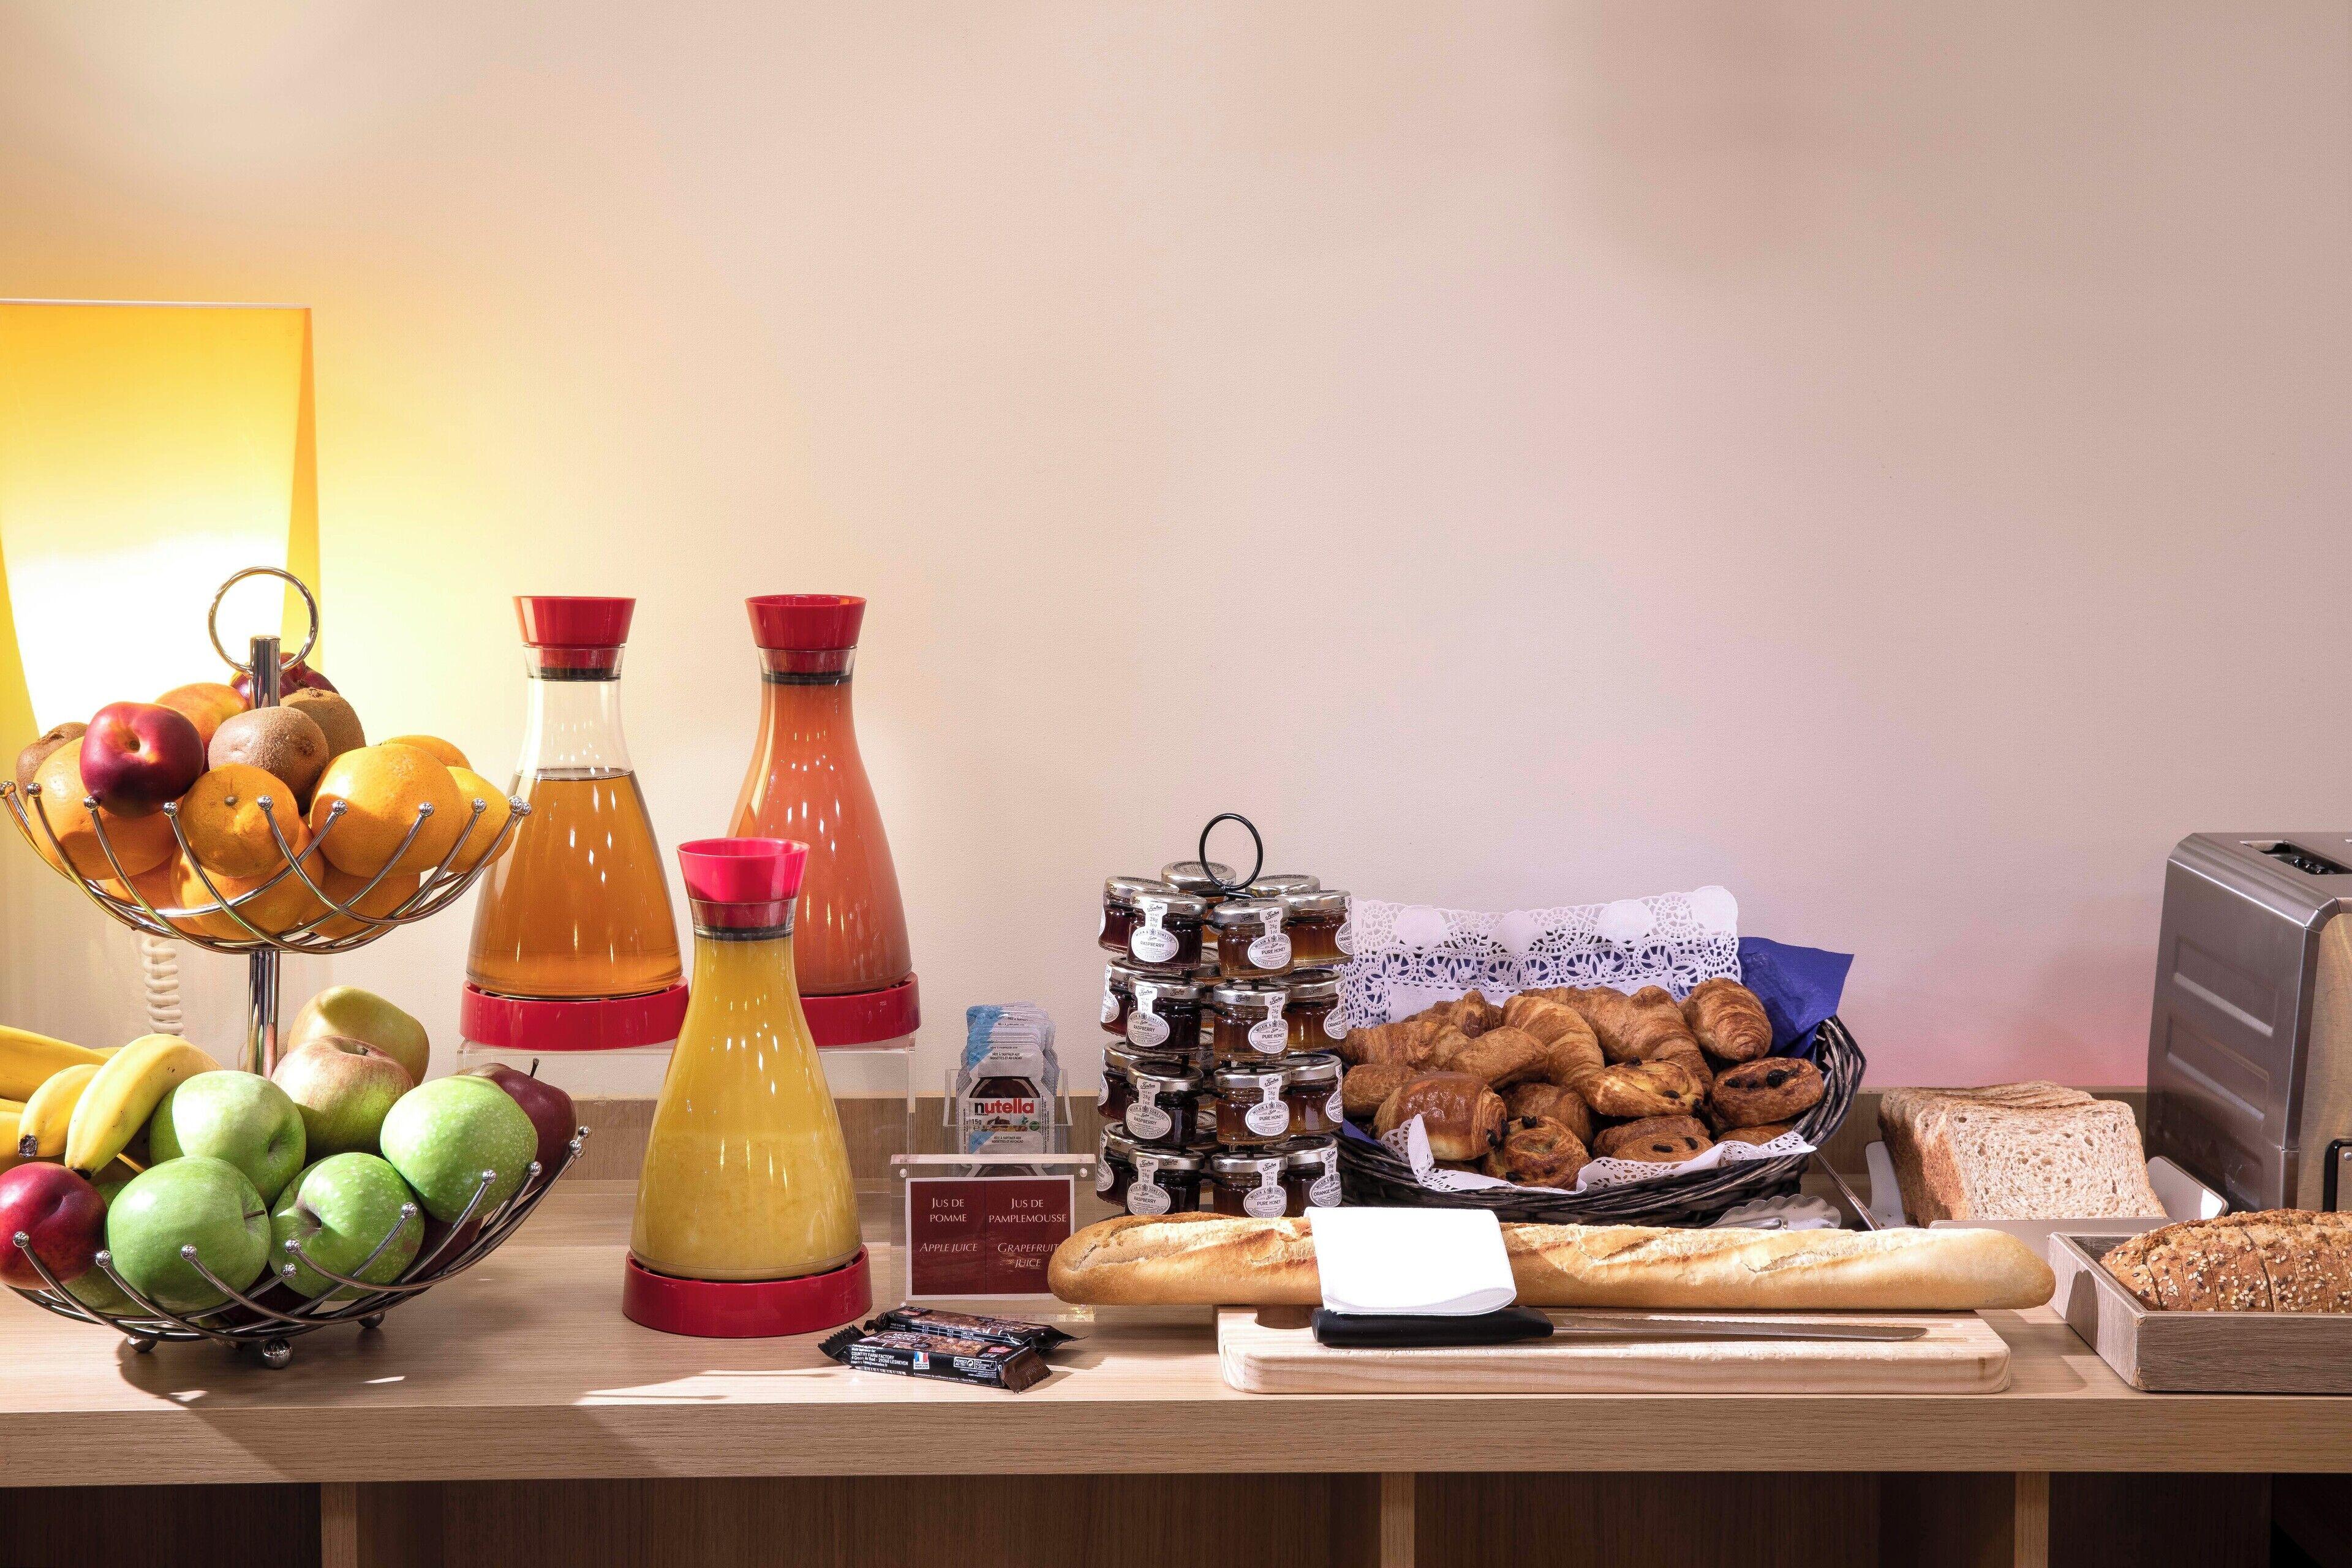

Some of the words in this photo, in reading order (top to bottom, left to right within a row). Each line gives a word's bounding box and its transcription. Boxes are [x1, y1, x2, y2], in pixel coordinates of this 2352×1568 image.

[1265, 911, 1280, 920] Tiptree
[1254, 940, 1266, 948] WILKIN
[1270, 996, 1283, 1005] Tiptree
[1256, 1024, 1267, 1032] WILKIN
[1265, 1078, 1279, 1087] Tiptree
[974, 1099, 1034, 1114] nutella
[1252, 1106, 1264, 1114] WILKIN
[1134, 1116, 1157, 1125] RASPBERRY
[1262, 1162, 1277, 1171] Tiptree
[1316, 1179, 1326, 1189] WILKIN
[1250, 1190, 1262, 1199] WILKIN
[931, 1197, 948, 1209] JUS
[1011, 1198, 1027, 1210] JUS
[929, 1214, 967, 1223] POMME
[989, 1214, 1067, 1223] PAMPLEMOUSSE
[919, 1243, 949, 1252] APPLE
[951, 1243, 978, 1253] JUICE
[997, 1243, 1058, 1253] GRAPEFRUIT
[1014, 1258, 1041, 1268] JUICE
